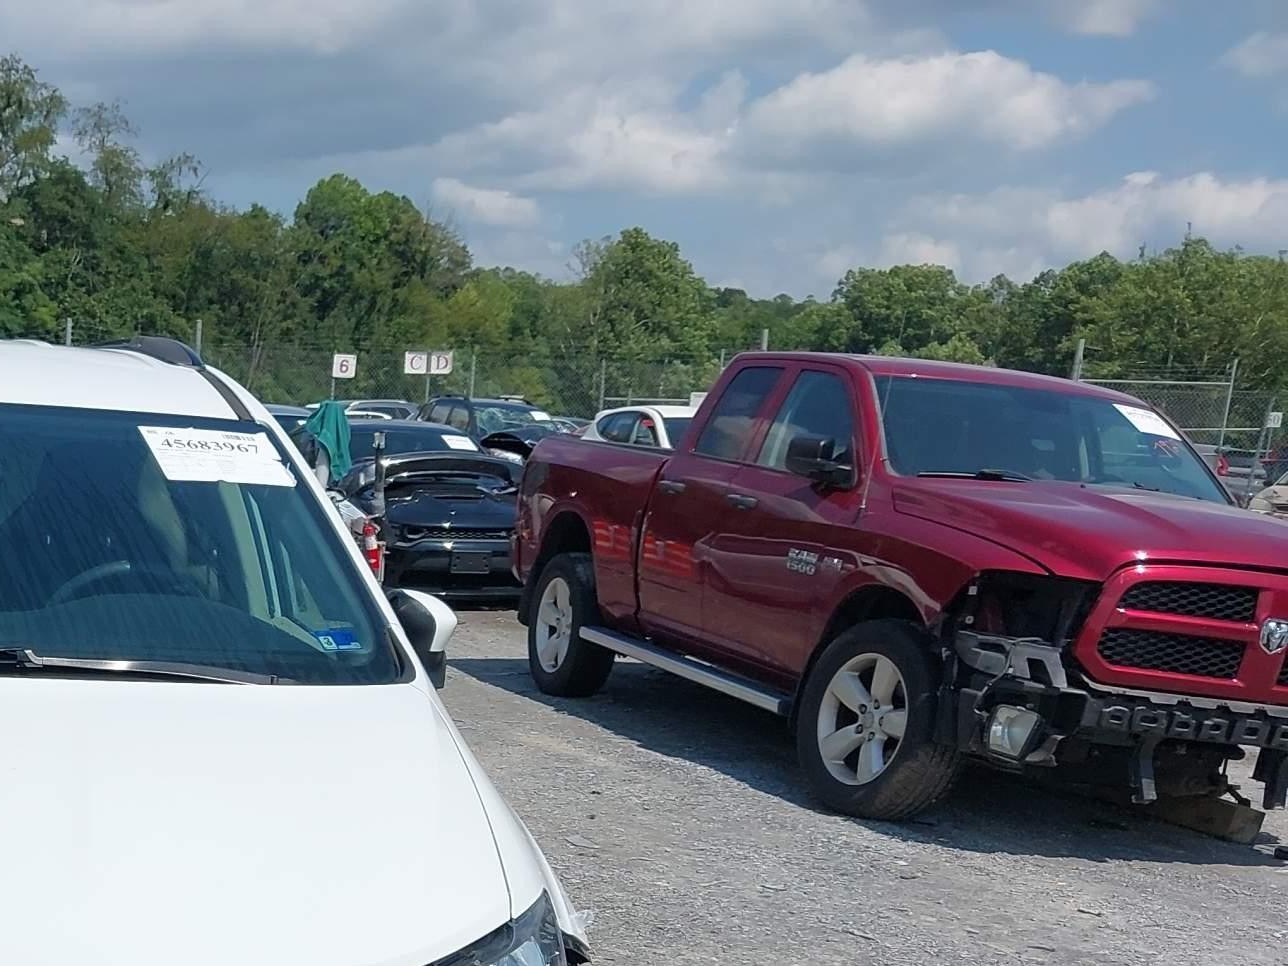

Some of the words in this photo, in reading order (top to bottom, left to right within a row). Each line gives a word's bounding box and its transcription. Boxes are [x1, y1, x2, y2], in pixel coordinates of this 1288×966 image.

[339, 359, 350, 374] 6
[409, 355, 423, 370] C
[435, 355, 449, 370] D
[160, 438, 259, 455] 45683967
